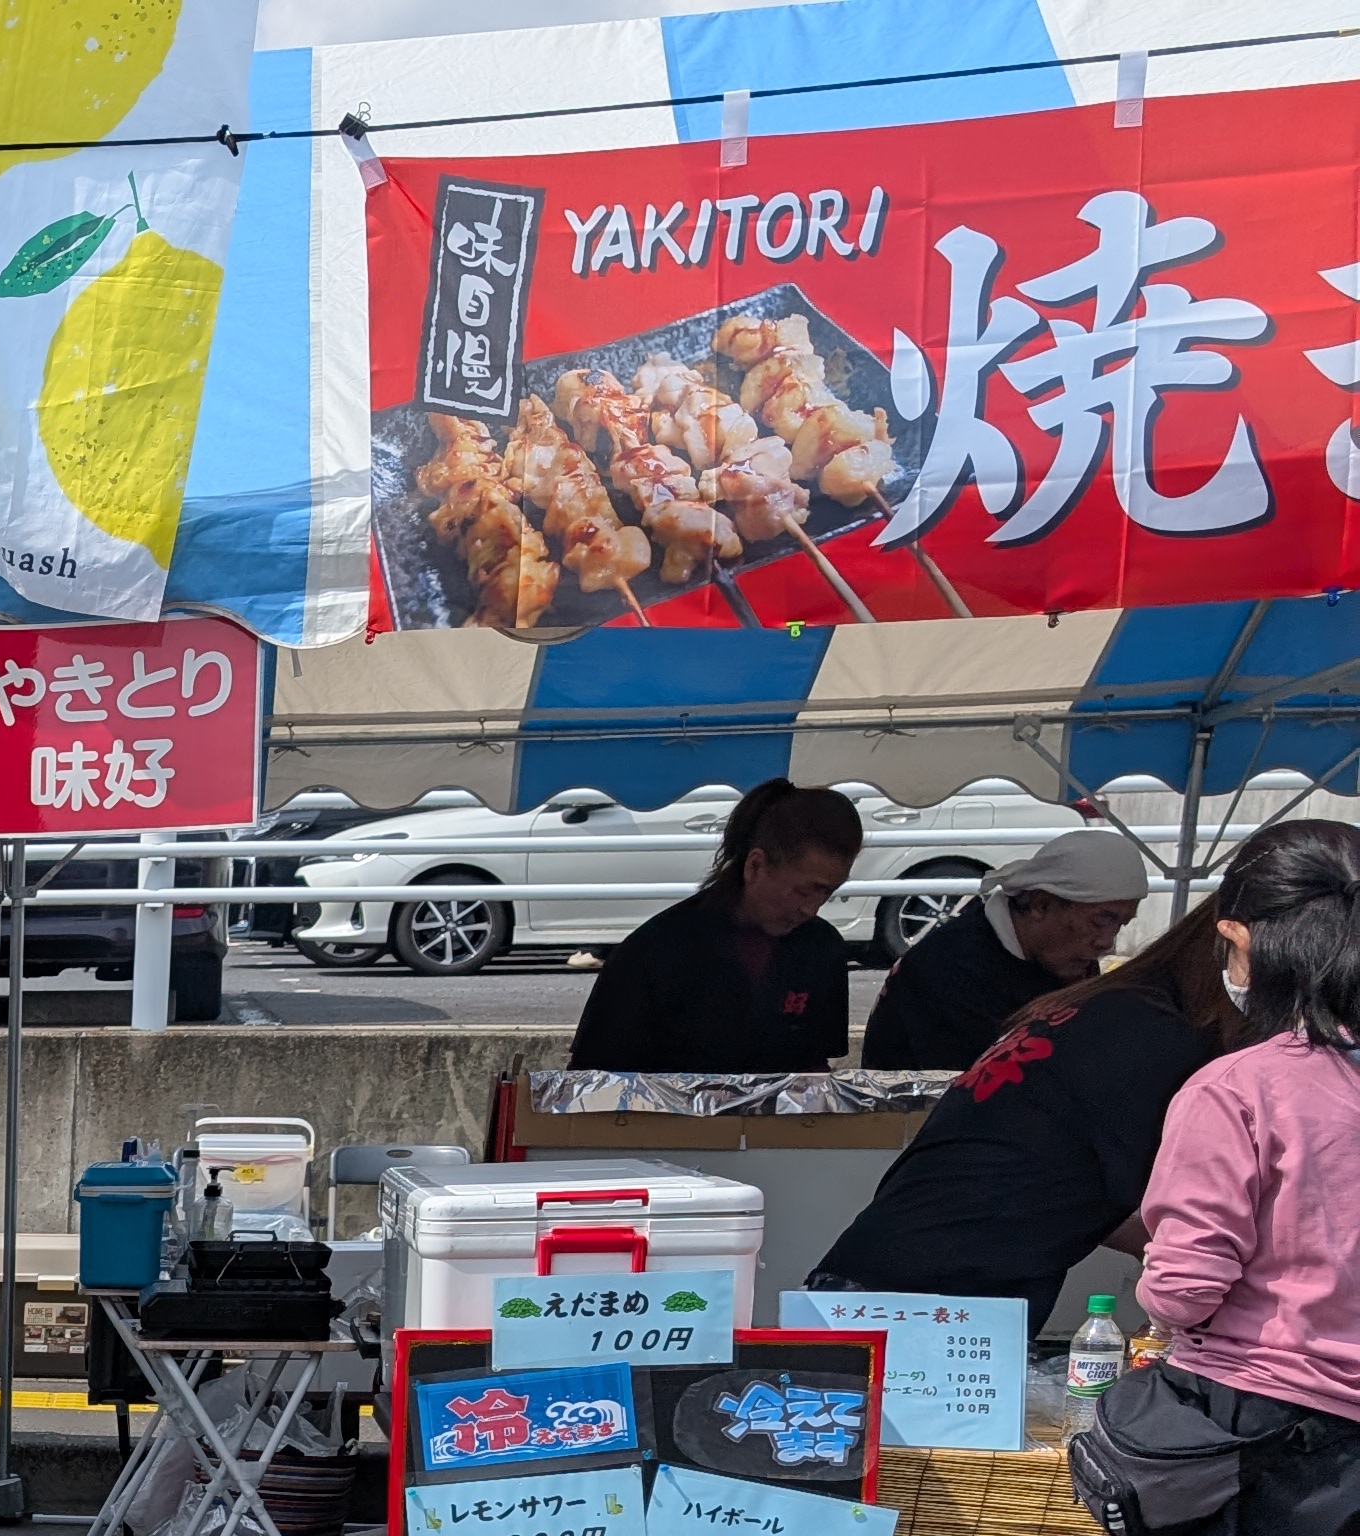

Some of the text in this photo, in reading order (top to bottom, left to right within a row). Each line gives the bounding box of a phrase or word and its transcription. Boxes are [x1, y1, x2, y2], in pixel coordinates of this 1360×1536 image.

[564, 185, 886, 276] YAKITORI
[440, 198, 518, 402] 味自慢
[869, 189, 1360, 549] 焼
[30, 738, 176, 812] 味好
[542, 1290, 650, 1319] えだまめ
[590, 1327, 695, 1352] 100円
[946, 1348, 992, 1361] 300円
[947, 1335, 992, 1348] 300円
[947, 1372, 991, 1385] 100円
[1076, 1360, 1119, 1371] MITSUYA
[1085, 1370, 1119, 1380] CIDER
[955, 1387, 997, 1399] 100円
[446, 1388, 532, 1453] 冷
[717, 1383, 865, 1440] 冷えて
[944, 1402, 990, 1415] 100円
[774, 1426, 855, 1465] ます
[450, 1493, 587, 1525] レモンサワー
[681, 1500, 785, 1536] ハイボール
